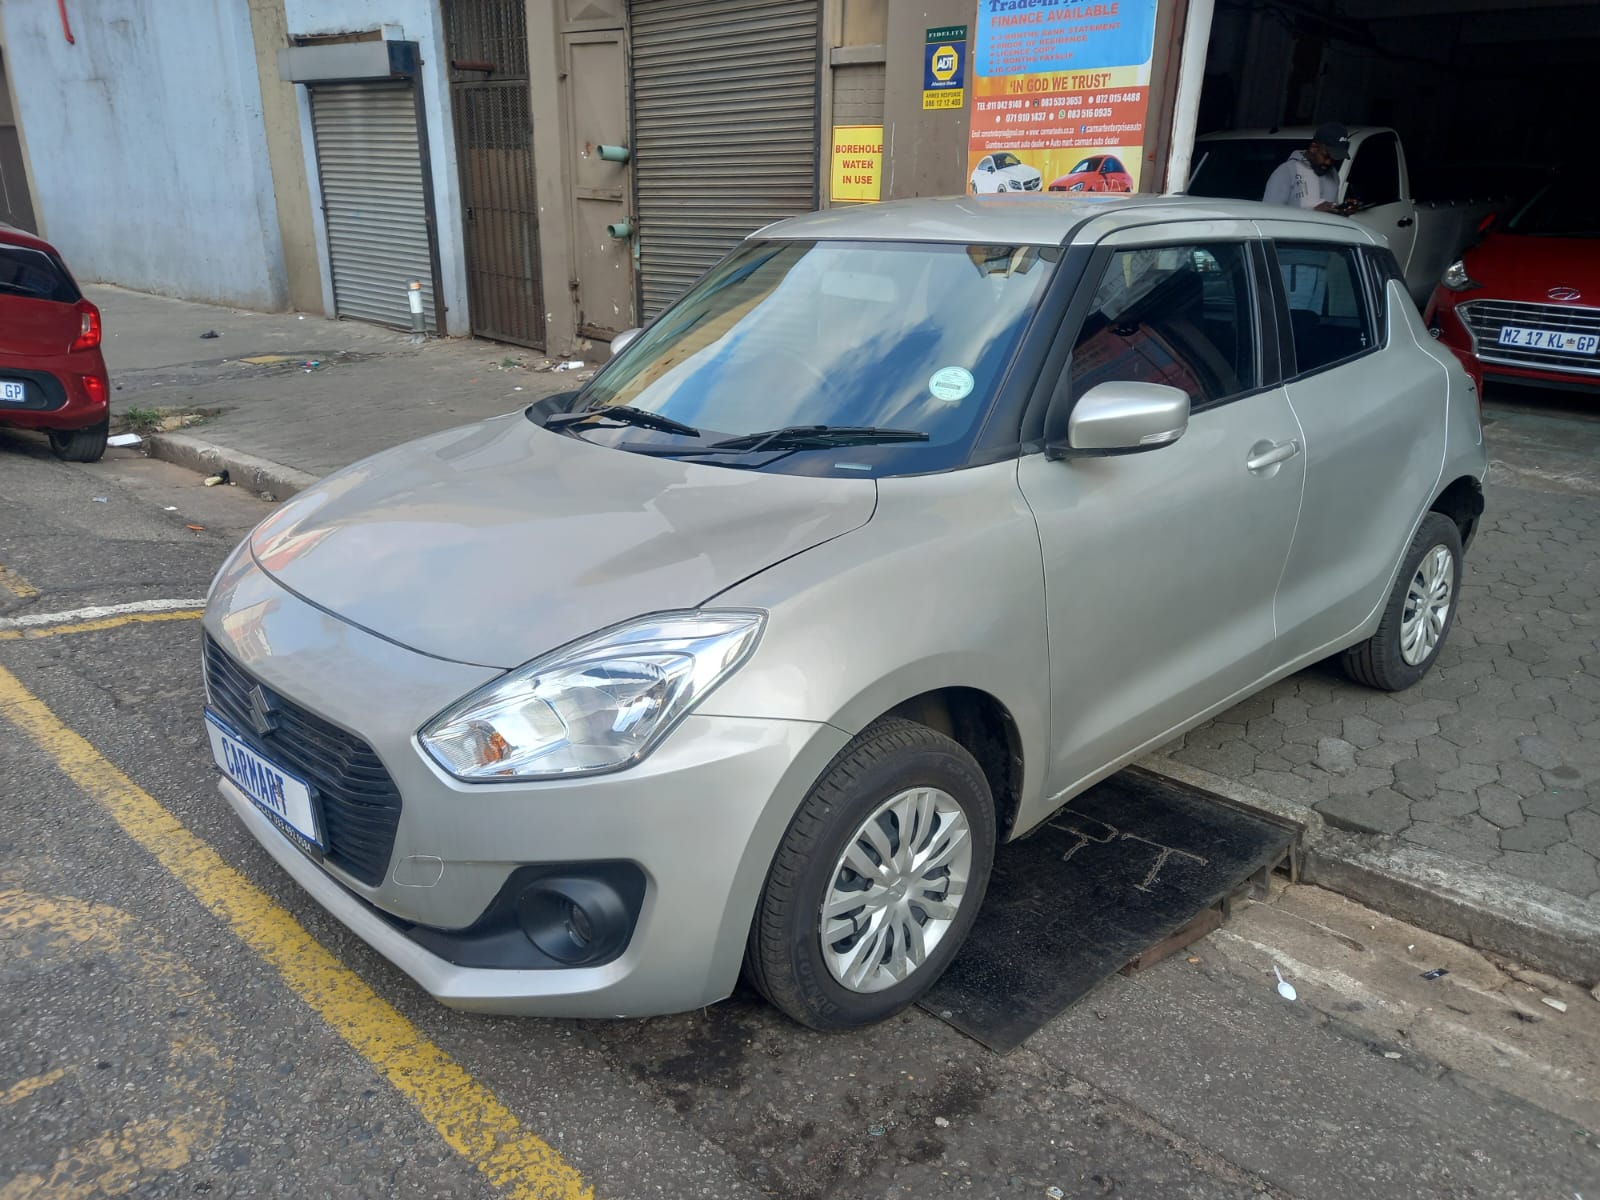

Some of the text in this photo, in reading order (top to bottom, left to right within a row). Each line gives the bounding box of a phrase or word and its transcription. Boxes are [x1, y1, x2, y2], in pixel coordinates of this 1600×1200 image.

[991, 3, 1120, 28] FINANCE AVAILABLE
[1069, 22, 1121, 33] STATEMENT
[928, 30, 965, 38] FIDELITY
[937, 56, 954, 70] ADT
[1027, 78, 1049, 91] GOD
[1052, 76, 1068, 90] WE
[1096, 94, 1108, 104] 072
[1109, 93, 1121, 103] 015
[835, 144, 883, 154] BOREHOLE
[842, 160, 874, 169] WATER
[842, 175, 873, 184] IN USE
[1502, 328, 1596, 351] MZ 17 KL GP
[5, 384, 22, 399] GP
[221, 736, 287, 817] CARMART
